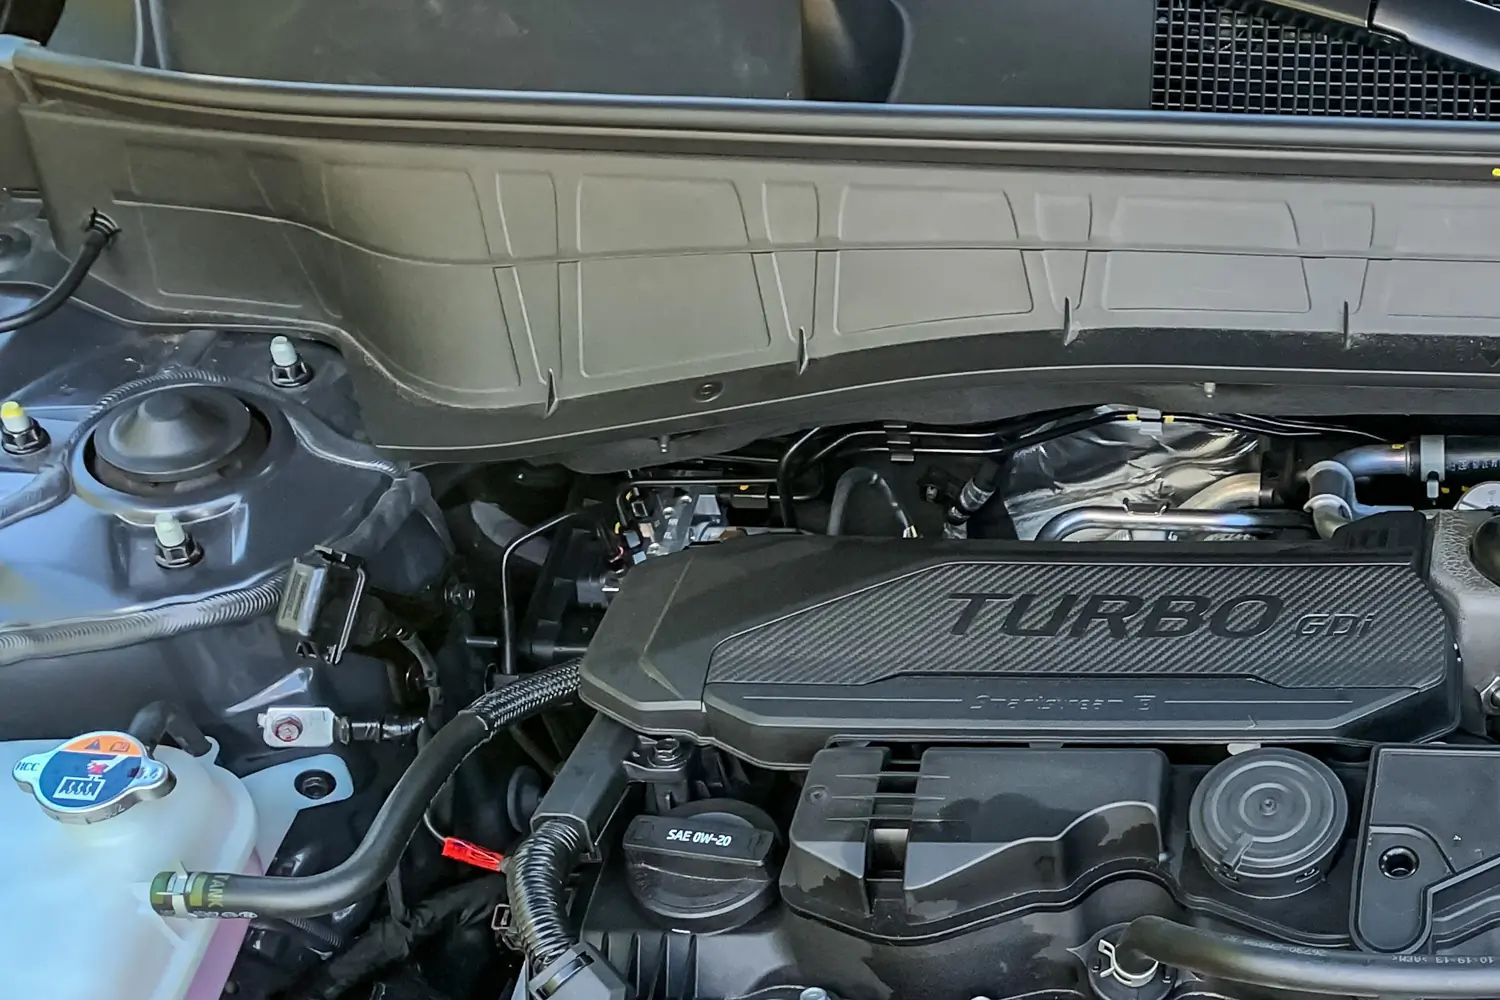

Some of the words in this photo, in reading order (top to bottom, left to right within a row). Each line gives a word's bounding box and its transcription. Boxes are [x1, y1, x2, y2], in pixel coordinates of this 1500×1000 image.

[946, 592, 1285, 639] TURBO
[1293, 612, 1376, 638] GDi
[14, 760, 41, 772] HCC
[665, 829, 693, 842] SAE
[692, 831, 732, 847] 0W-20
[207, 874, 231, 908] TANK
